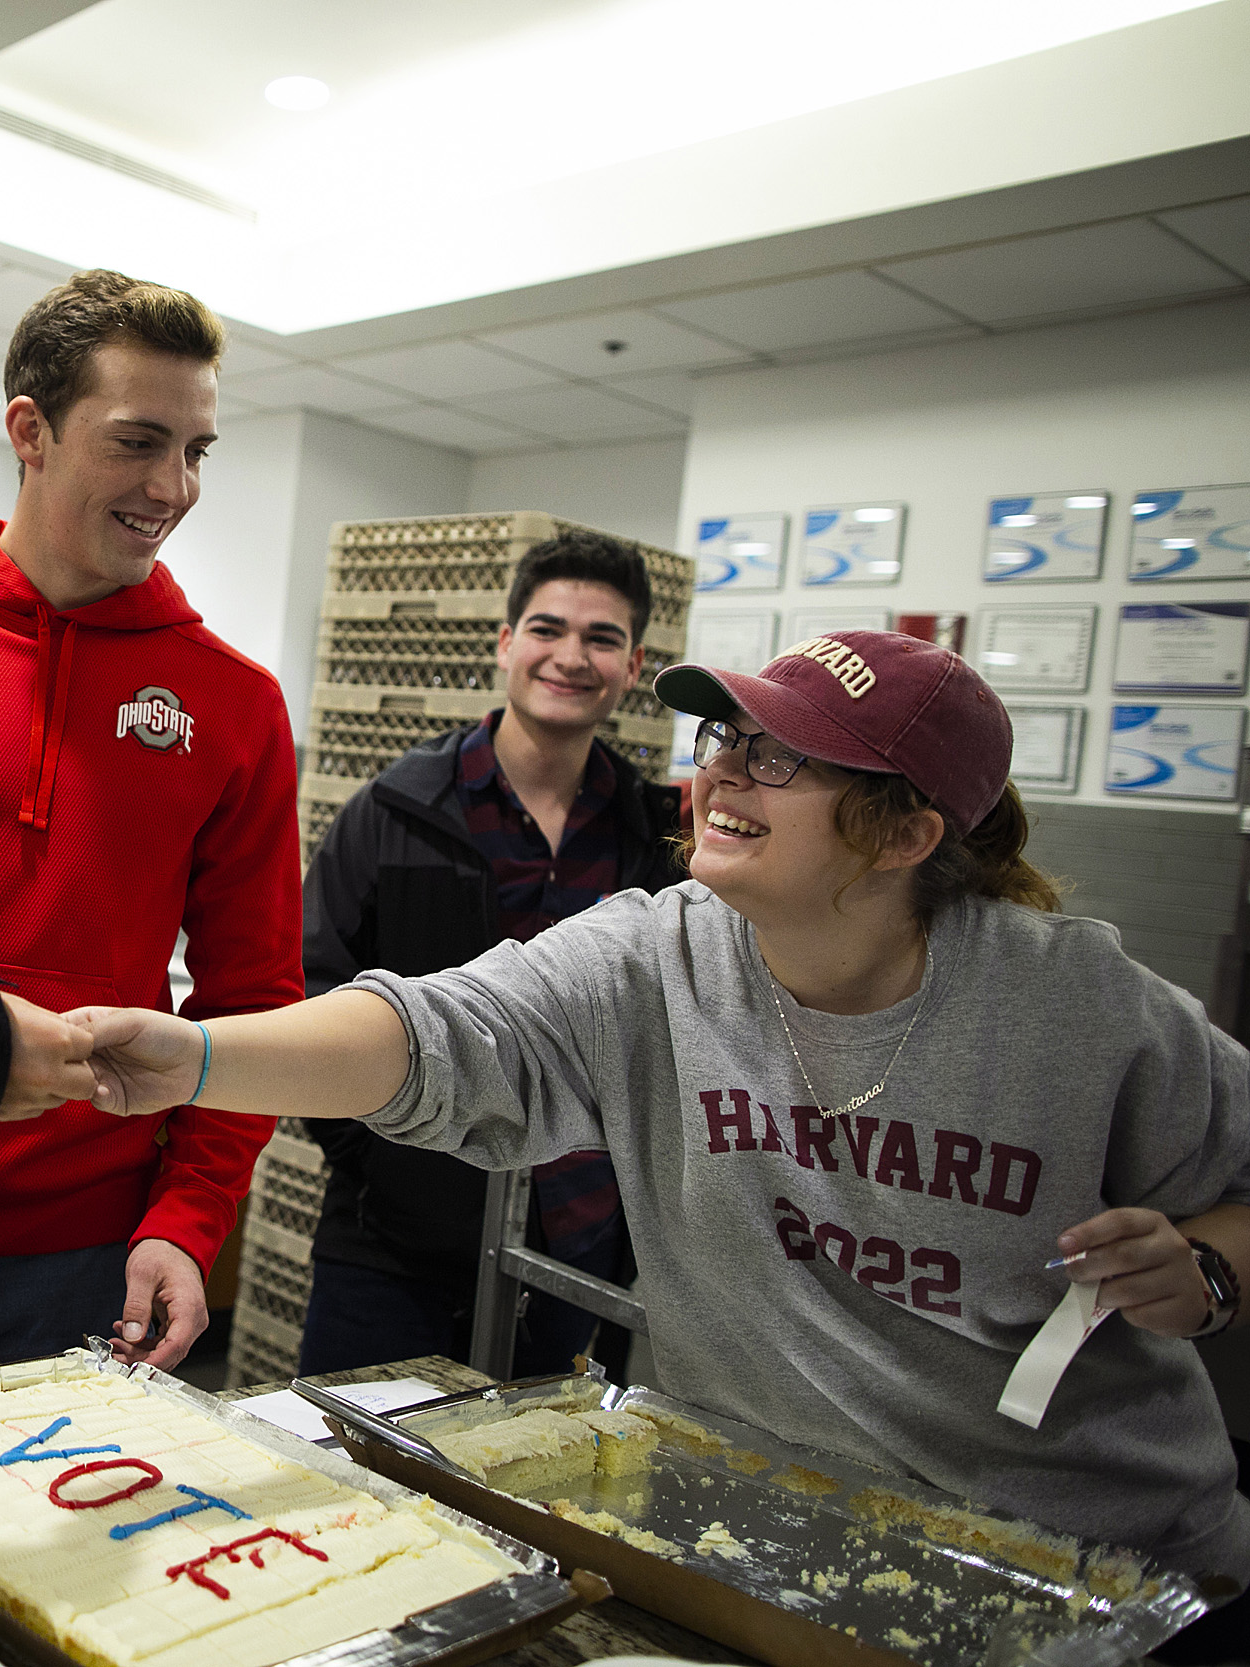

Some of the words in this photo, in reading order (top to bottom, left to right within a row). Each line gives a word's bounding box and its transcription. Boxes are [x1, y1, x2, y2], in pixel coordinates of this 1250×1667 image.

[758, 637, 877, 699] VARD
[820, 1080, 885, 1120] montana
[698, 1088, 1043, 1217] HARVARD
[773, 1196, 962, 1318] 2022
